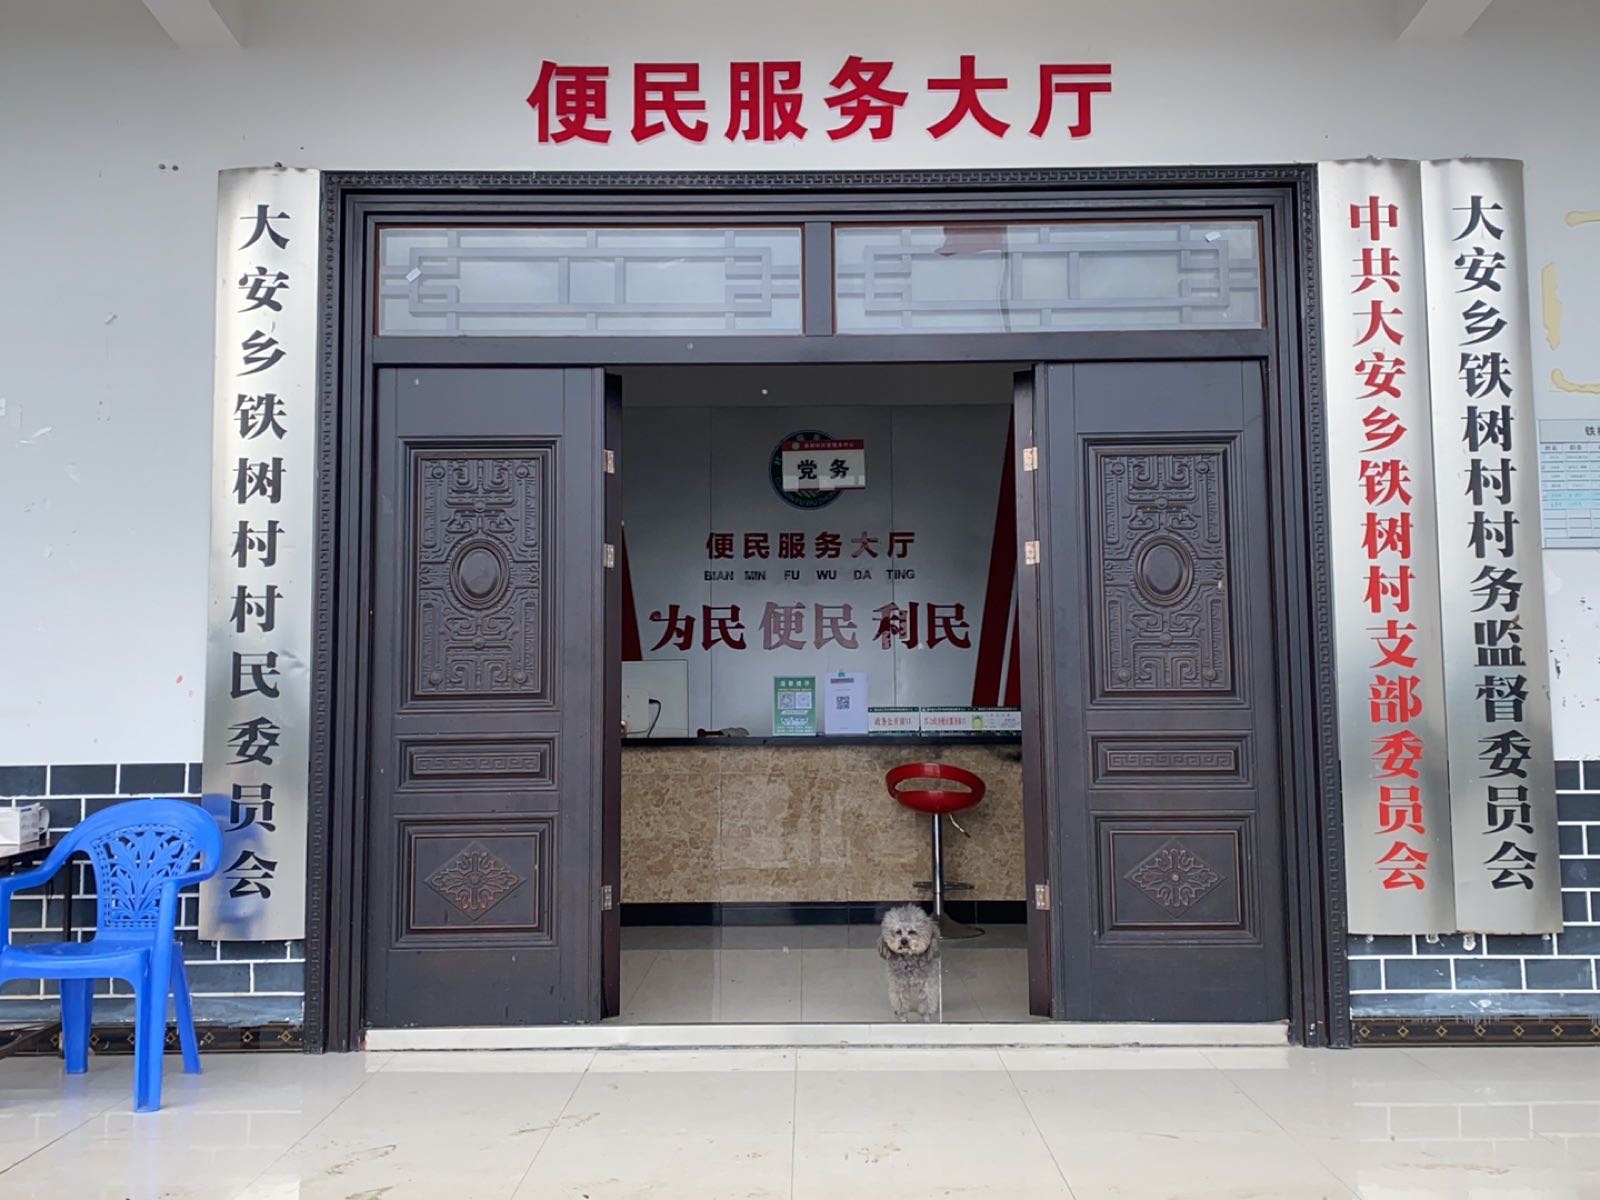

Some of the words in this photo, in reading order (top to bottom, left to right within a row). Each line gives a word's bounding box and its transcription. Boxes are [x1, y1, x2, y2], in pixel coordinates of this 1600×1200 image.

[526, 55, 1113, 144] 便民服务大厅
[797, 458, 849, 480] 党务
[224, 203, 290, 900] 大安乡铁树村村民委员会
[704, 570, 734, 581] BIAN
[784, 570, 800, 581] FU
[816, 569, 837, 580] WU
[853, 569, 872, 580] DA
[885, 568, 916, 580] TING
[705, 530, 916, 560] 便民服务大厅
[1349, 195, 1429, 890] 中共大安乡铁树村支部委员会
[1452, 195, 1538, 890] 大安乡铁树村村务监督委员会
[649, 603, 747, 652] 为民
[758, 601, 859, 651] 便民
